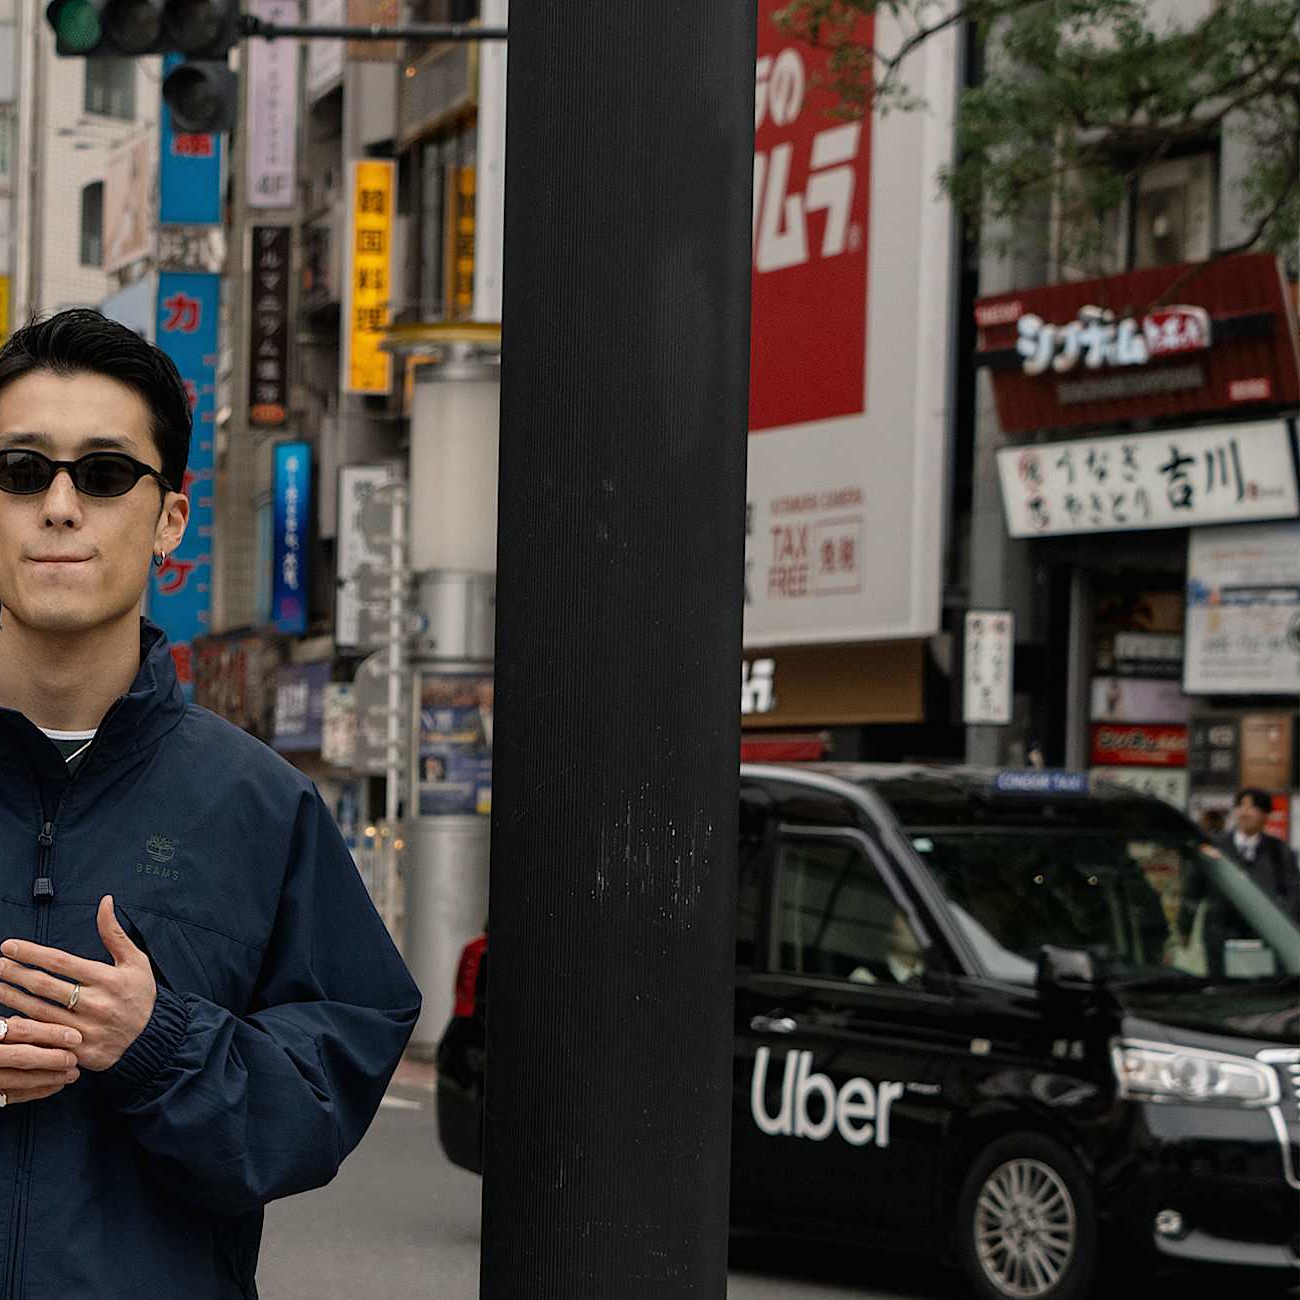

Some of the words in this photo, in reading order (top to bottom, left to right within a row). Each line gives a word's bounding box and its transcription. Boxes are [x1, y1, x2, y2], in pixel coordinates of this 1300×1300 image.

[753, 120, 861, 274] ムラ
[1159, 438, 1246, 511] 吉川
[770, 525, 808, 561] TAX
[766, 562, 808, 599] FREE
[751, 1046, 904, 1148] Uber
